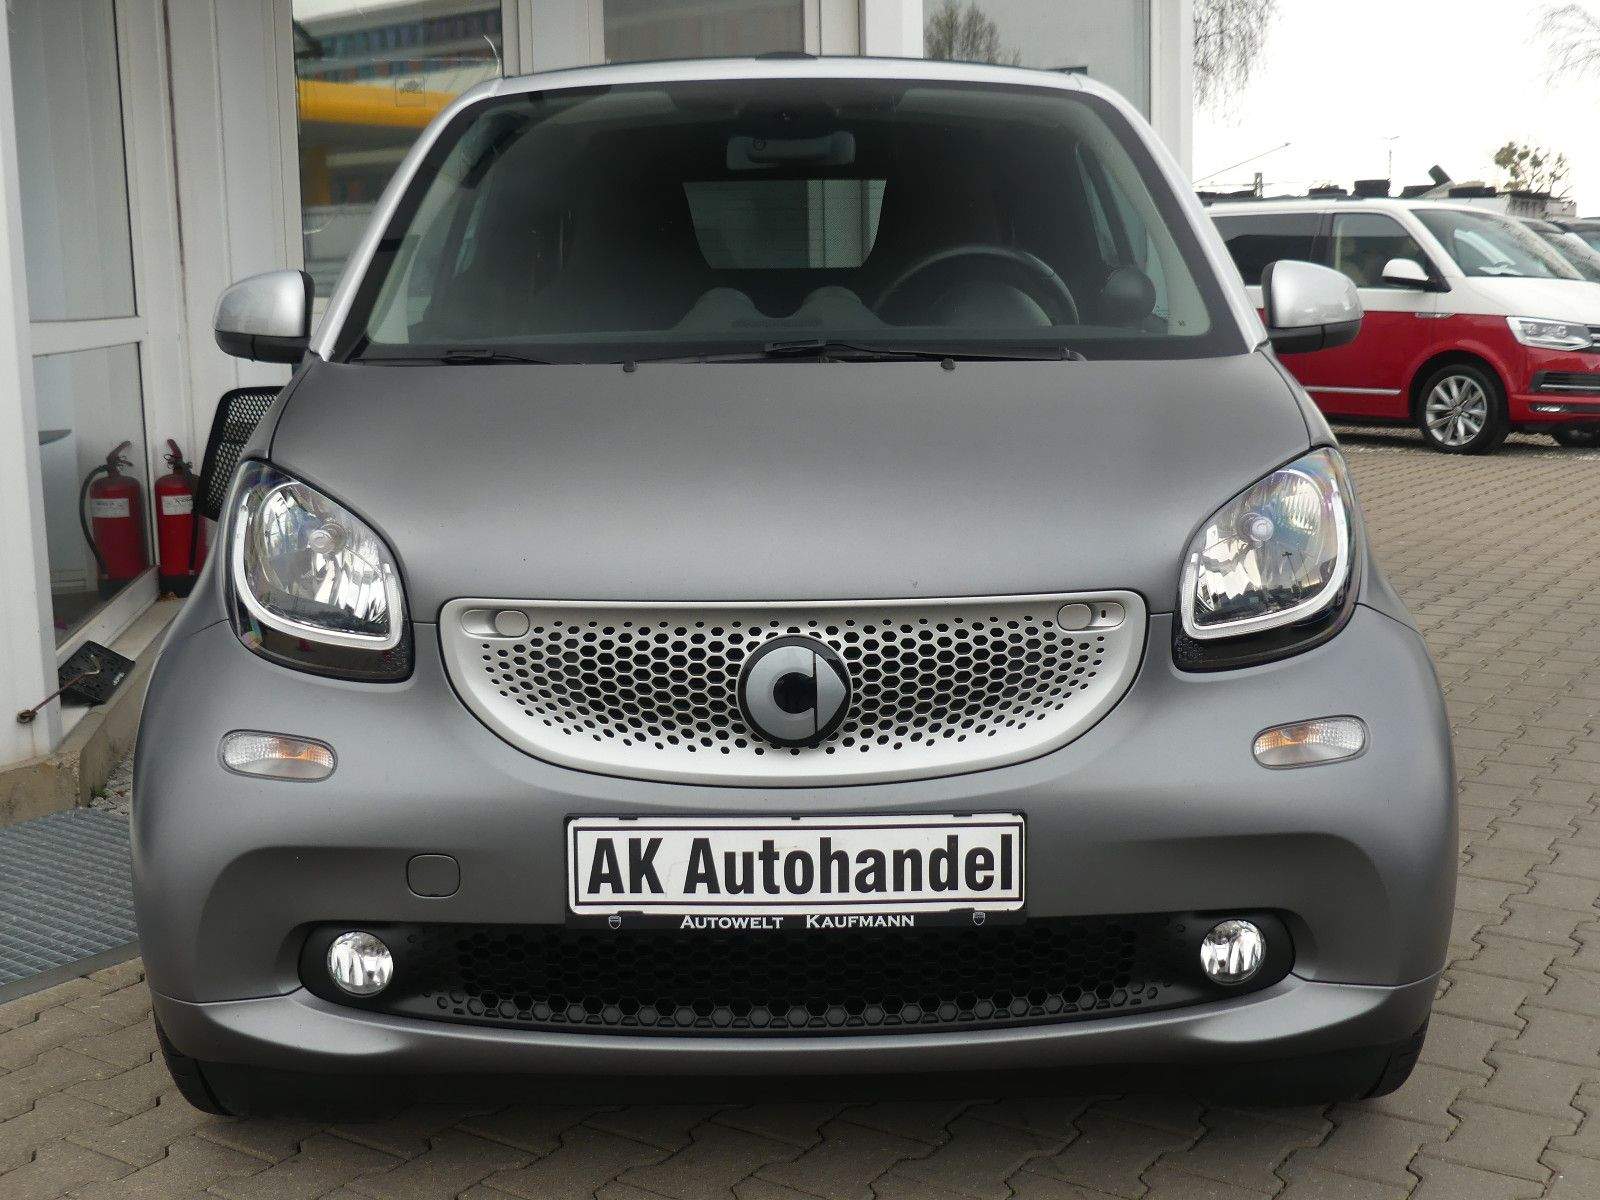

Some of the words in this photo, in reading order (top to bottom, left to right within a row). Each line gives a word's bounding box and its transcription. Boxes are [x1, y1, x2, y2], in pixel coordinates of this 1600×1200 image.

[587, 837, 664, 894] AK
[683, 833, 1013, 895] Autohandel
[679, 914, 784, 930] AUTOWELT
[805, 914, 915, 929] KAUFMANN
